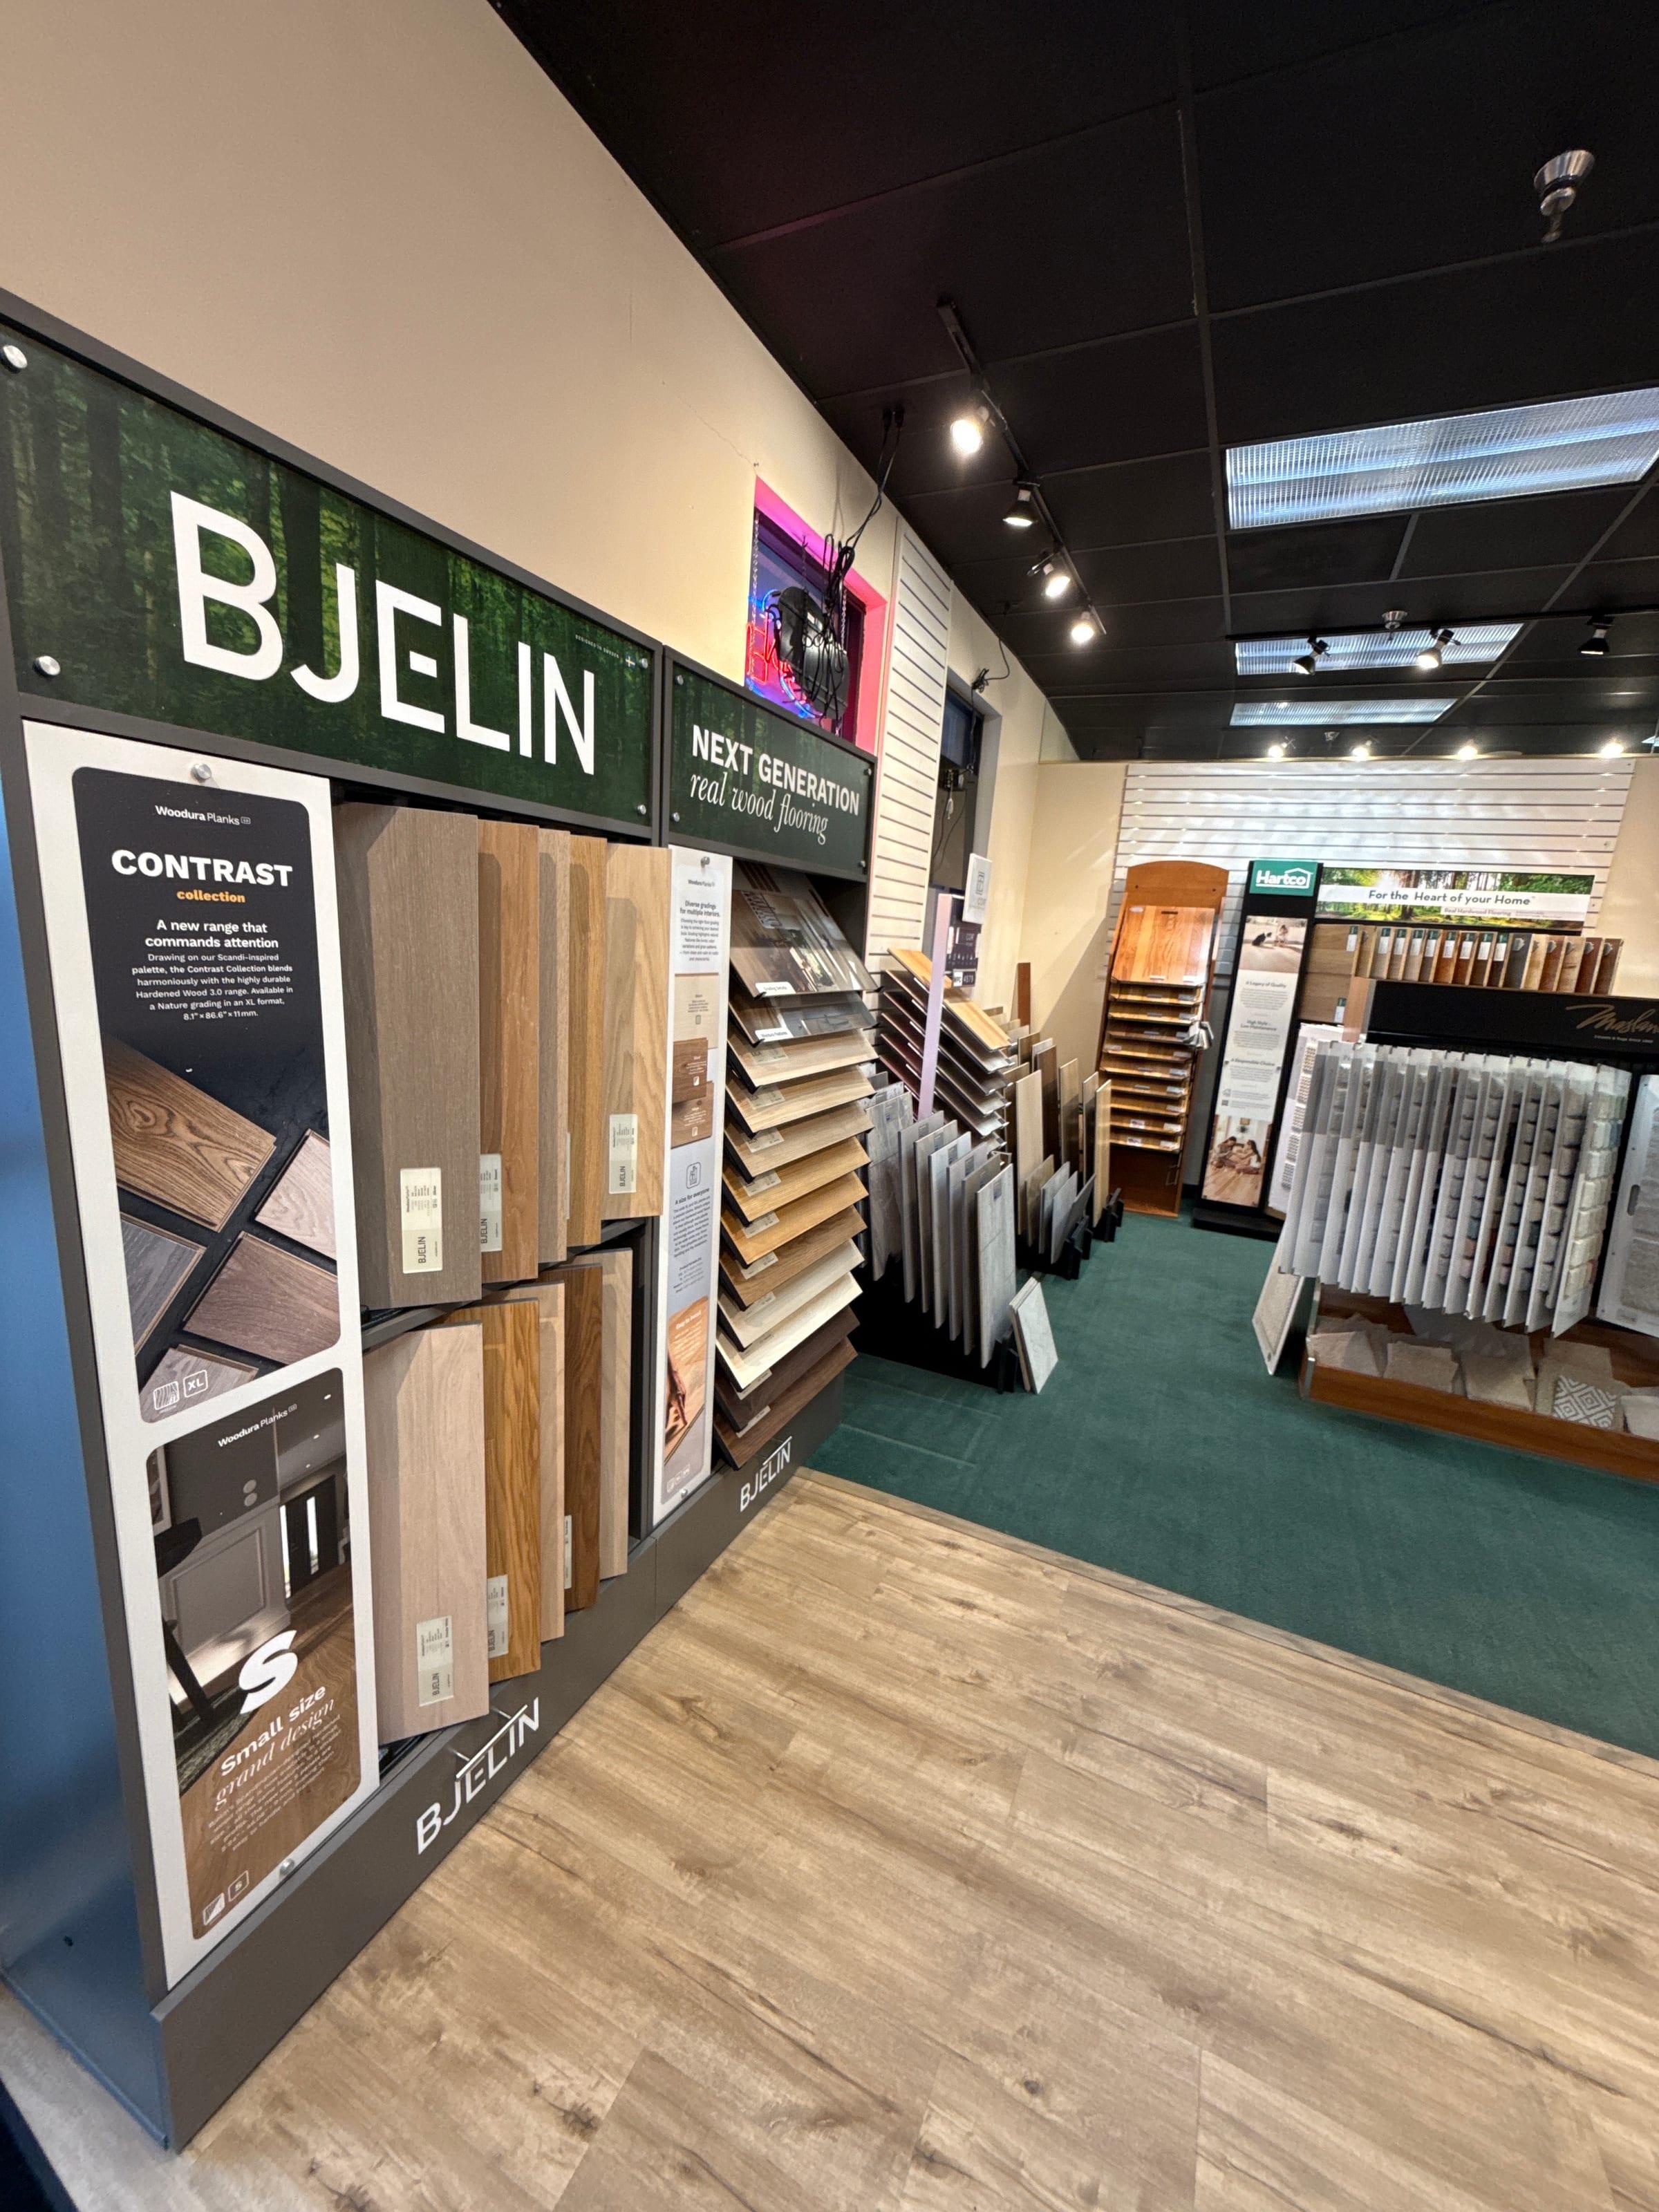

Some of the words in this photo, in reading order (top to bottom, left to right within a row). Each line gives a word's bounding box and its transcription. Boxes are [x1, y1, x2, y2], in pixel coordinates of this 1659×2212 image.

[171, 491, 594, 776] BJELIN
[693, 724, 753, 775] NEXT
[758, 753, 859, 816] GENERATION
[155, 805, 205, 821] Woodura
[207, 812, 240, 826] Planks
[690, 771, 727, 806] real
[731, 787, 776, 821] wood
[774, 794, 828, 845] flooring
[111, 850, 292, 886] CONTRAST
[1256, 870, 1306, 885] Hartco
[176, 890, 245, 903] collection
[1369, 890, 1387, 899] For
[1391, 891, 1409, 901] the
[1414, 892, 1446, 902] Heart
[1450, 893, 1463, 902] of
[1465, 895, 1491, 905] your
[1494, 895, 1530, 906] Home
[157, 919, 167, 930] A
[171, 921, 200, 931] new
[203, 922, 239, 934] range
[242, 922, 268, 933] that
[145, 937, 221, 948] commands
[224, 937, 279, 948] attention
[148, 953, 185, 963] Drawing
[218, 953, 279, 964] Scandi-inspired
[131, 966, 168, 975] palette,
[170, 965, 185, 973] the
[187, 965, 224, 973] Contrast
[226, 964, 265, 973] Collection
[268, 964, 293, 972] blends
[137, 977, 198, 988] harmoniously
[200, 976, 219, 985] with
[221, 976, 235, 984] the
[237, 975, 261, 986] highly
[262, 975, 290, 983] durable
[135, 988, 180, 999] Hardened
[182, 988, 207, 997] Wood
[209, 988, 222, 996] 3.0
[225, 988, 249, 997] range.
[251, 986, 284, 995] Available
[158, 1002, 188, 1011] Nature
[190, 1000, 222, 1011] grading
[257, 997, 285, 1006] format,
[1566, 1004, 1659, 1033] Maslan
[188, 1378, 204, 1391] XL
[218, 1423, 259, 1447] Woodura
[261, 1410, 288, 1427] Planks
[740, 1441, 791, 1512] BJELIN
[238, 1630, 298, 1714] S
[221, 1717, 283, 1777] Small
[289, 1686, 326, 1722] size
[214, 1742, 274, 1812] grand
[281, 1699, 334, 1751] design
[417, 1697, 539, 1855] BJELIN
